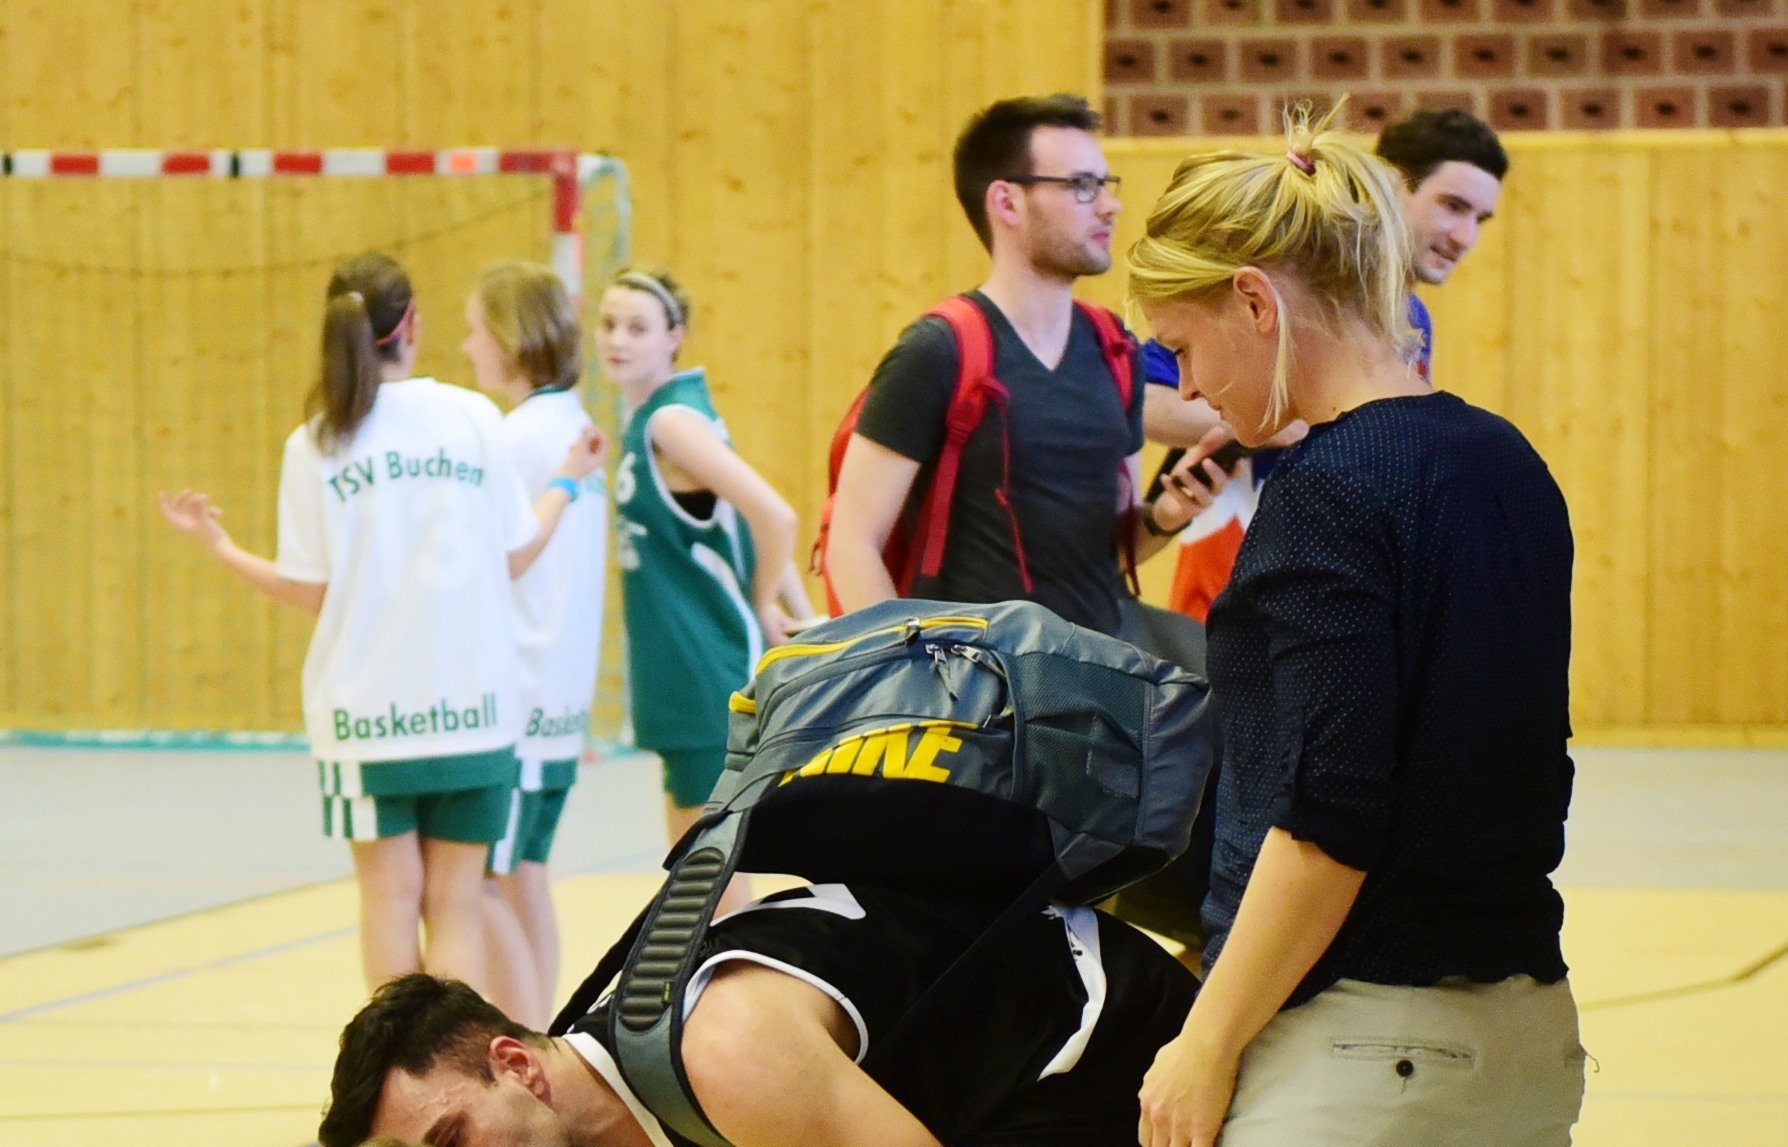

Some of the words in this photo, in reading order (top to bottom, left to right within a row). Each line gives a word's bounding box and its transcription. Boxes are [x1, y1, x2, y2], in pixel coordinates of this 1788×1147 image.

[328, 457, 374, 503] TSV
[386, 447, 484, 486] Buchen
[333, 692, 498, 740] Basketball
